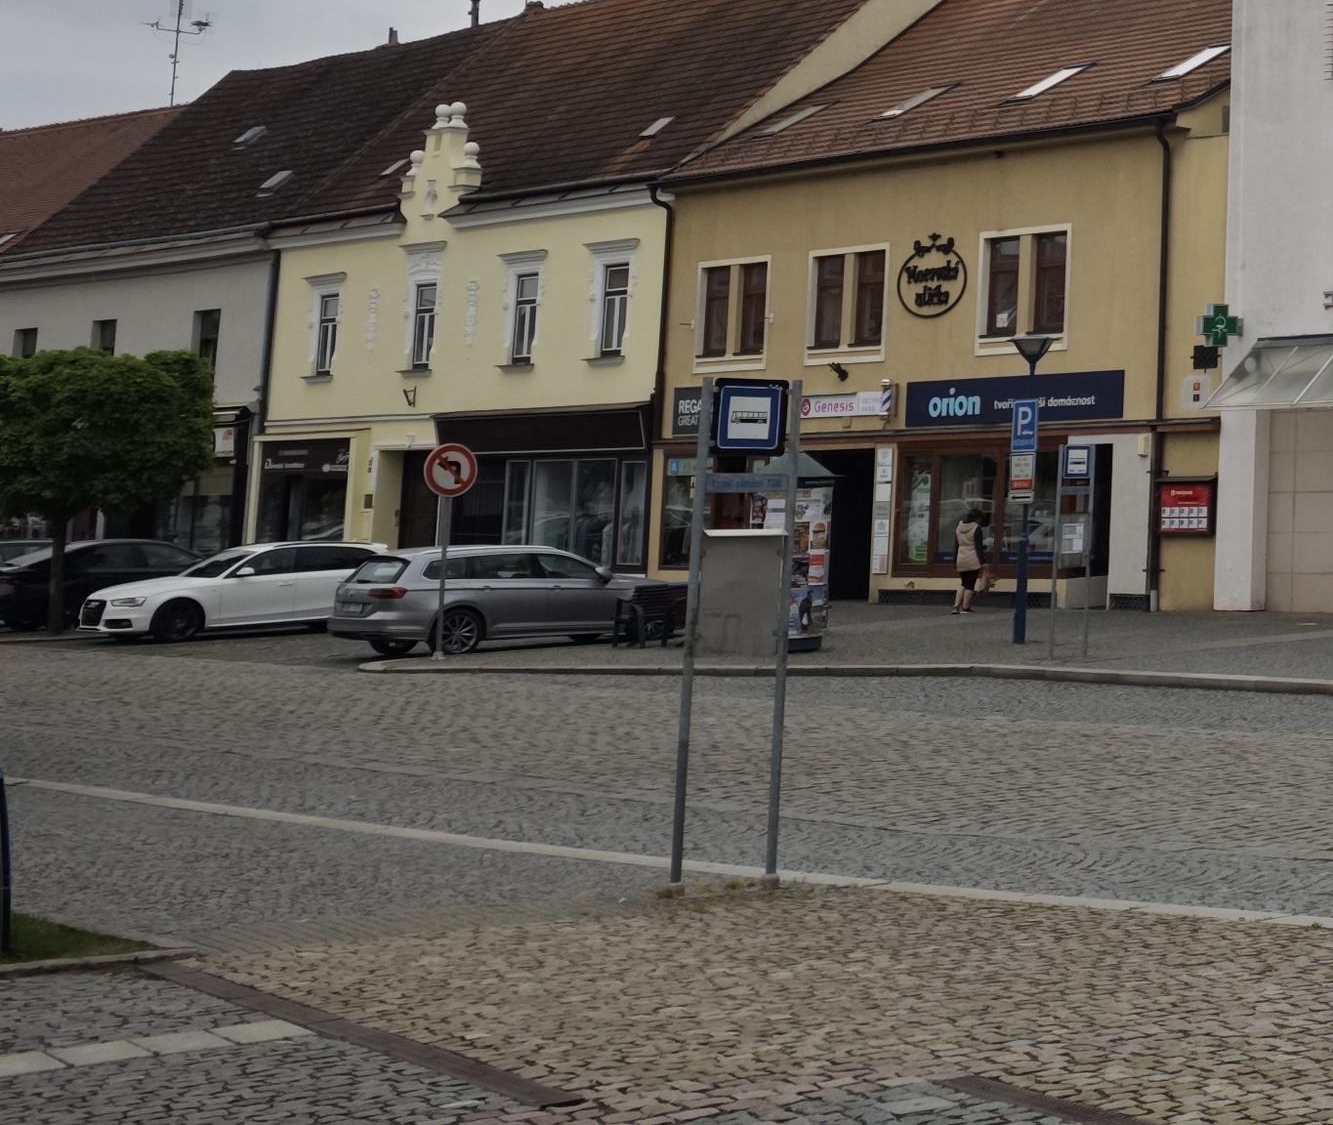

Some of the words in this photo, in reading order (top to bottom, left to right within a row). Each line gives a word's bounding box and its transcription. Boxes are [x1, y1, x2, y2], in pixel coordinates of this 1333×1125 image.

[814, 401, 854, 413] Genesis
[928, 387, 981, 418] orion
[1047, 394, 1096, 408] domácnost
[1017, 406, 1033, 436] P
